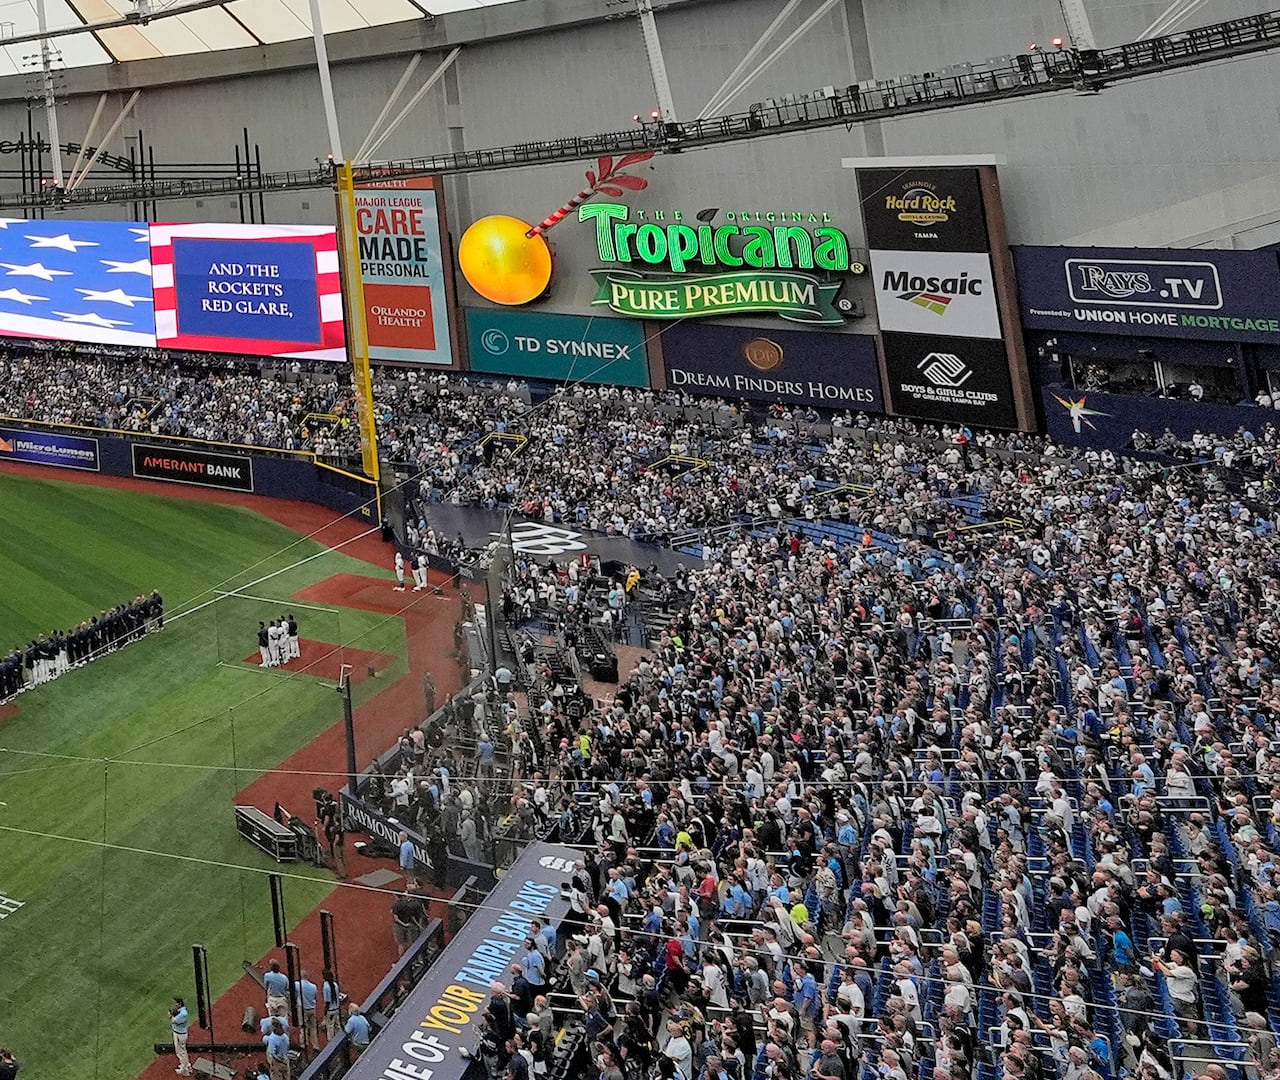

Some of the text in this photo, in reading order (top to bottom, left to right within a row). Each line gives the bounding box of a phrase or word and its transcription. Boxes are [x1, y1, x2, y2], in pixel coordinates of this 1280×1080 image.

[355, 198, 422, 207] MAJOR LEAGUE
[885, 195, 956, 212] Hard Rock
[357, 209, 425, 235] CARE
[637, 210, 832, 222] THE ORIGINAL
[359, 237, 428, 262] MADE
[578, 204, 849, 273] Tropicana
[209, 264, 279, 277] AND THE
[361, 263, 429, 278] PERSONAL
[1078, 265, 1204, 299] RAYS .TV
[208, 281, 283, 296] ROCKET'S
[883, 270, 982, 296] Mosaic
[611, 280, 816, 311] PURE PREMIUM
[202, 299, 293, 318] RED GLARE,
[371, 306, 426, 317] ORLANDO
[1030, 309, 1280, 332] Presented by UNION HOME MORTGAGE
[378, 316, 421, 328] HEALTH
[514, 336, 630, 360] TD SYNNEX
[671, 369, 874, 402] DREAM FINDERS HOMES
[901, 384, 925, 394] BOYS
[936, 388, 964, 397] GIRLS
[966, 391, 998, 401] CLUBS
[922, 394, 952, 402] GREATER
[16, 440, 94, 459] MicroLumen
[143, 456, 241, 480] AMERANT BANK
[347, 803, 400, 847] RAYMOND
[509, 880, 559, 916] RAYS
[491, 909, 533, 941] BAY
[455, 938, 520, 988] TAMPA
[420, 984, 487, 1034] YOUR
[402, 1029, 450, 1063] OF
